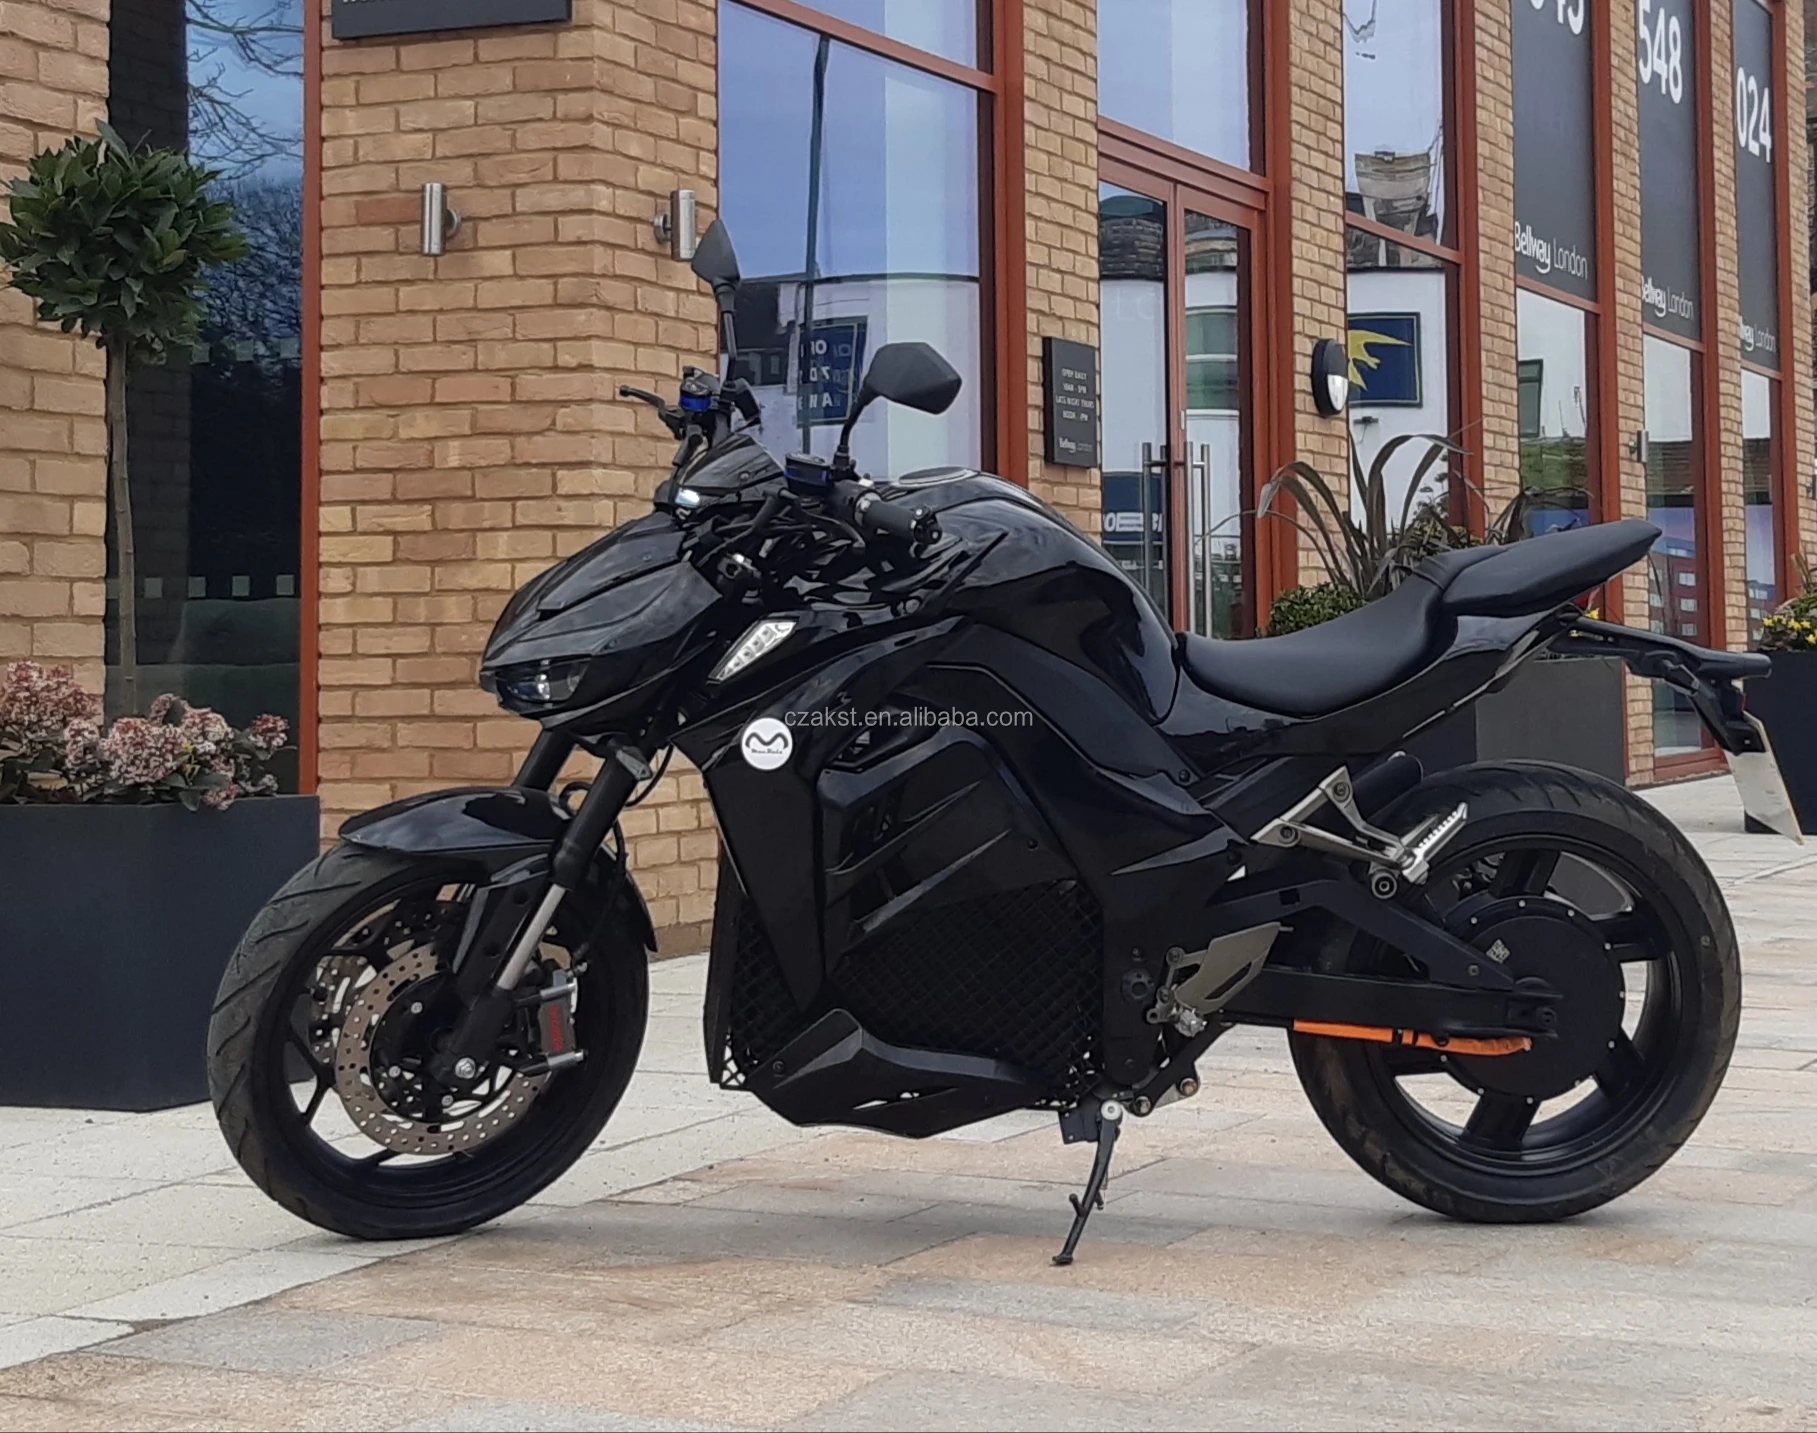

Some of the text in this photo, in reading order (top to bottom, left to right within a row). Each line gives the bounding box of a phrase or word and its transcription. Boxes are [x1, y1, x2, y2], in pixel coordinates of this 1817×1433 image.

[1638, 0, 1683, 104] 548
[1736, 66, 1772, 163] 024
[1514, 220, 1588, 280] Bellway London
[1667, 286, 1694, 320] London
